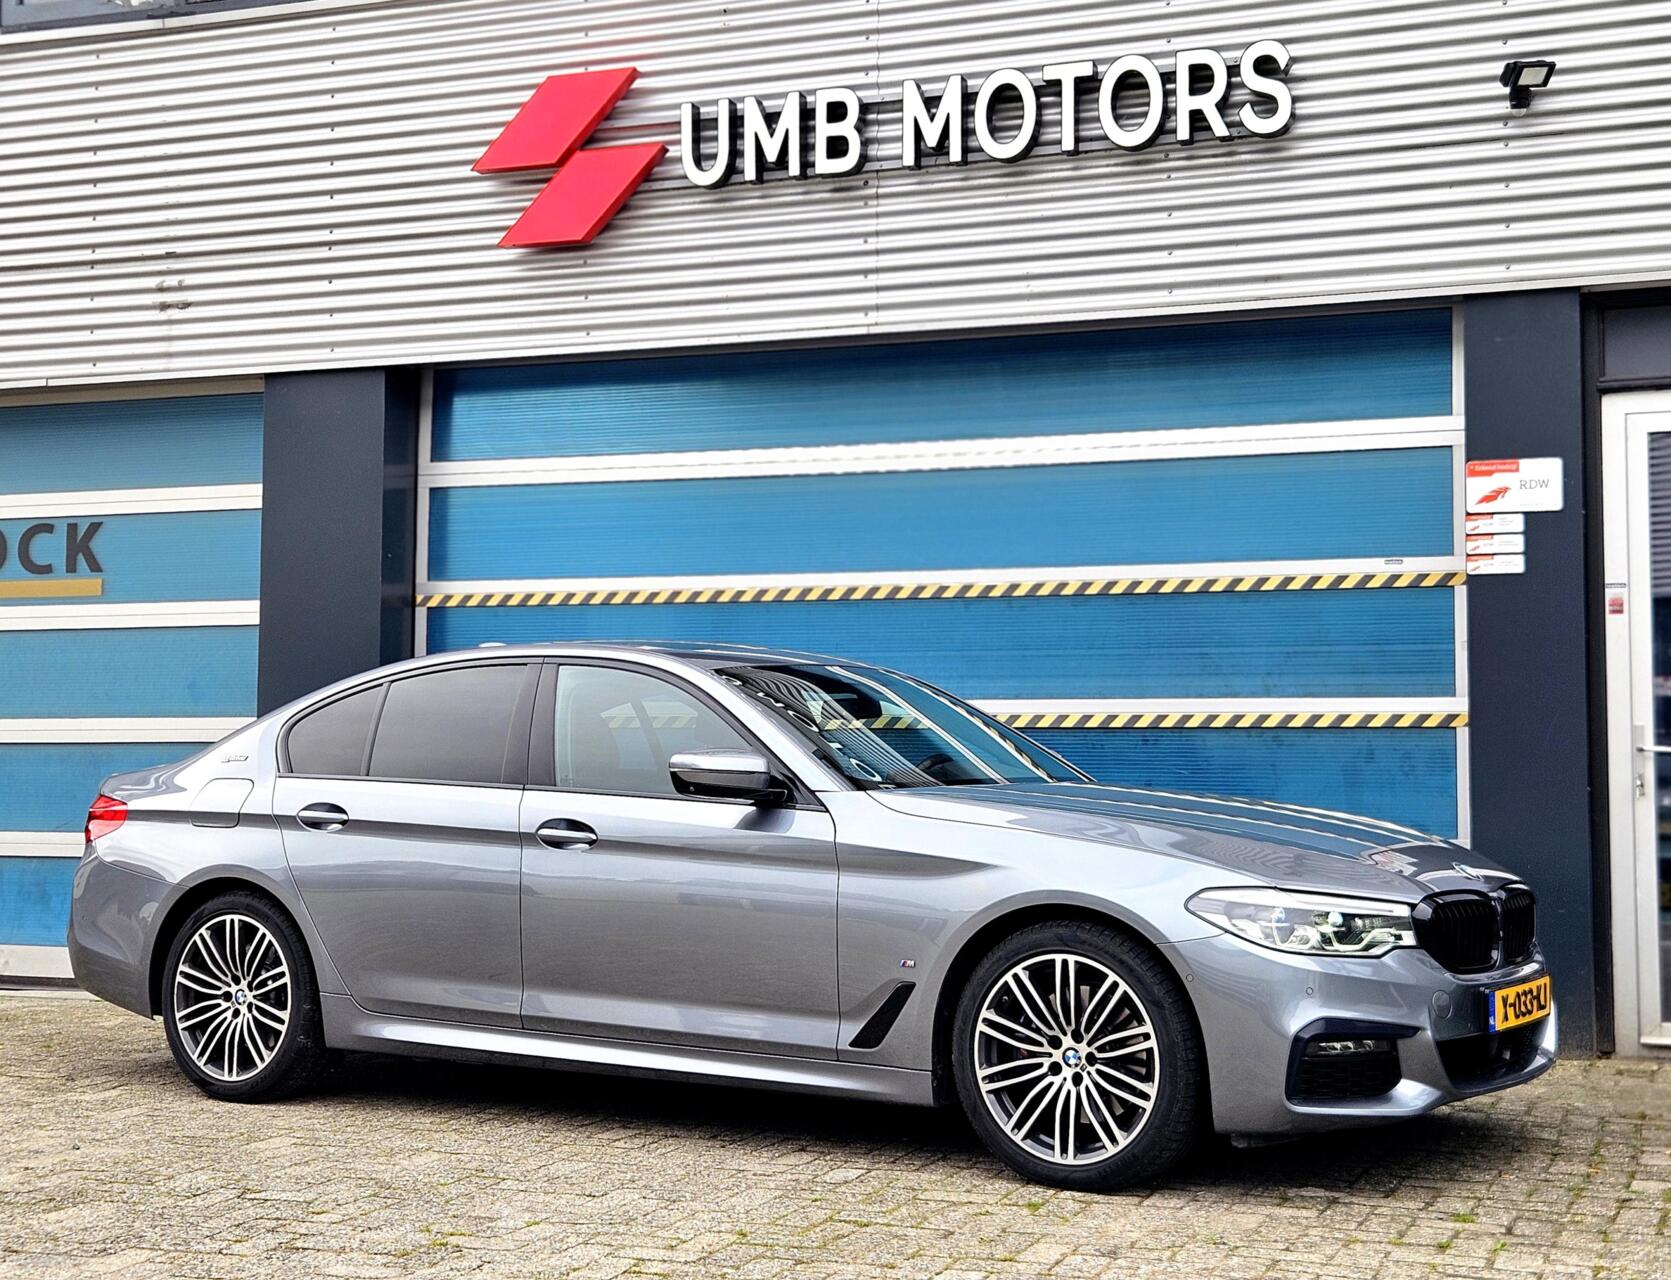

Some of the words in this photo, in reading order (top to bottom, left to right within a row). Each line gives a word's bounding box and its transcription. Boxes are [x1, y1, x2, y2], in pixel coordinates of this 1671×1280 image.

[680, 87, 863, 188] UMB
[902, 39, 1293, 168] MOTORS
[1519, 478, 1550, 490] RDW
[0, 521, 104, 575] CK
